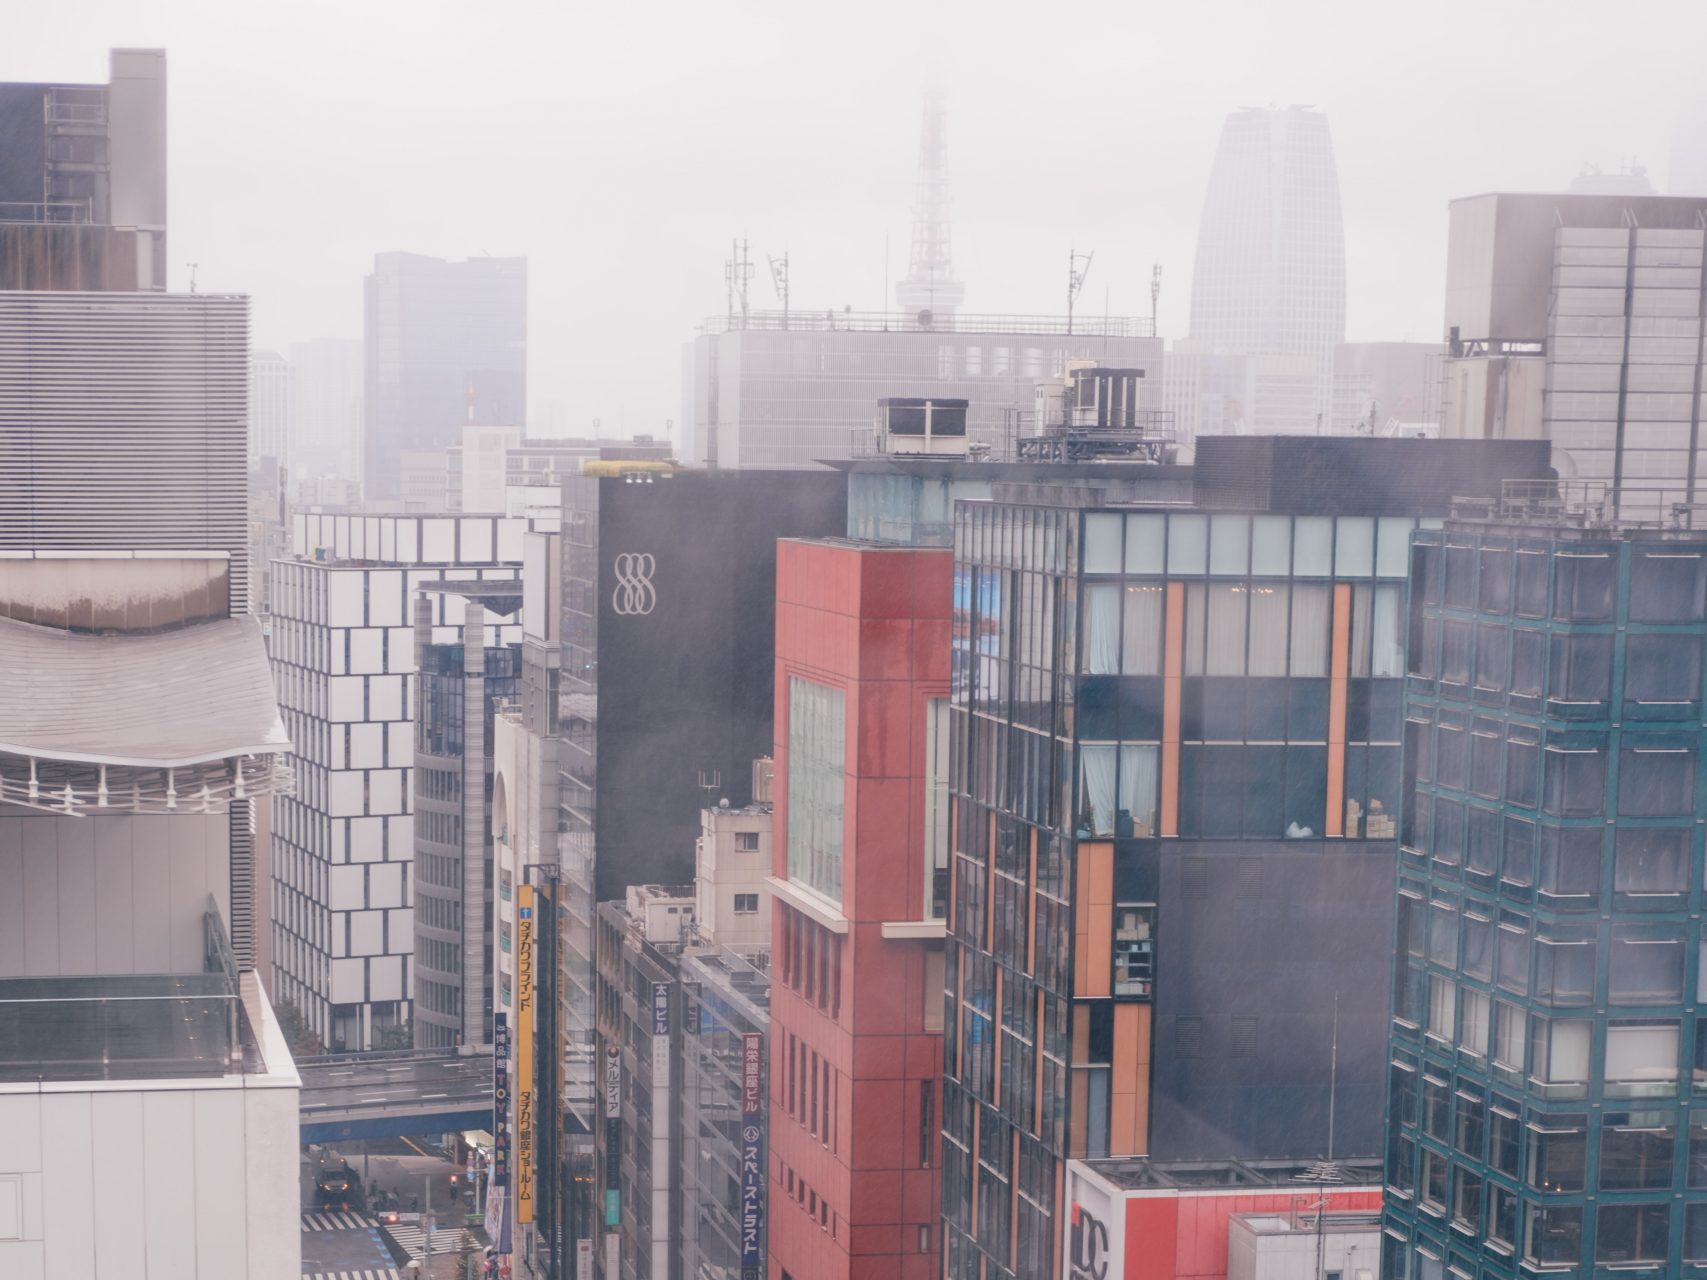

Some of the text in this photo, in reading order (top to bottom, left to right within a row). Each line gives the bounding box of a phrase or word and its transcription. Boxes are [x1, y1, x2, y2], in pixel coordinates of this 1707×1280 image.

[496, 1074, 506, 1176] TOY PARK
[743, 1146, 758, 1255] スペーストラスト
